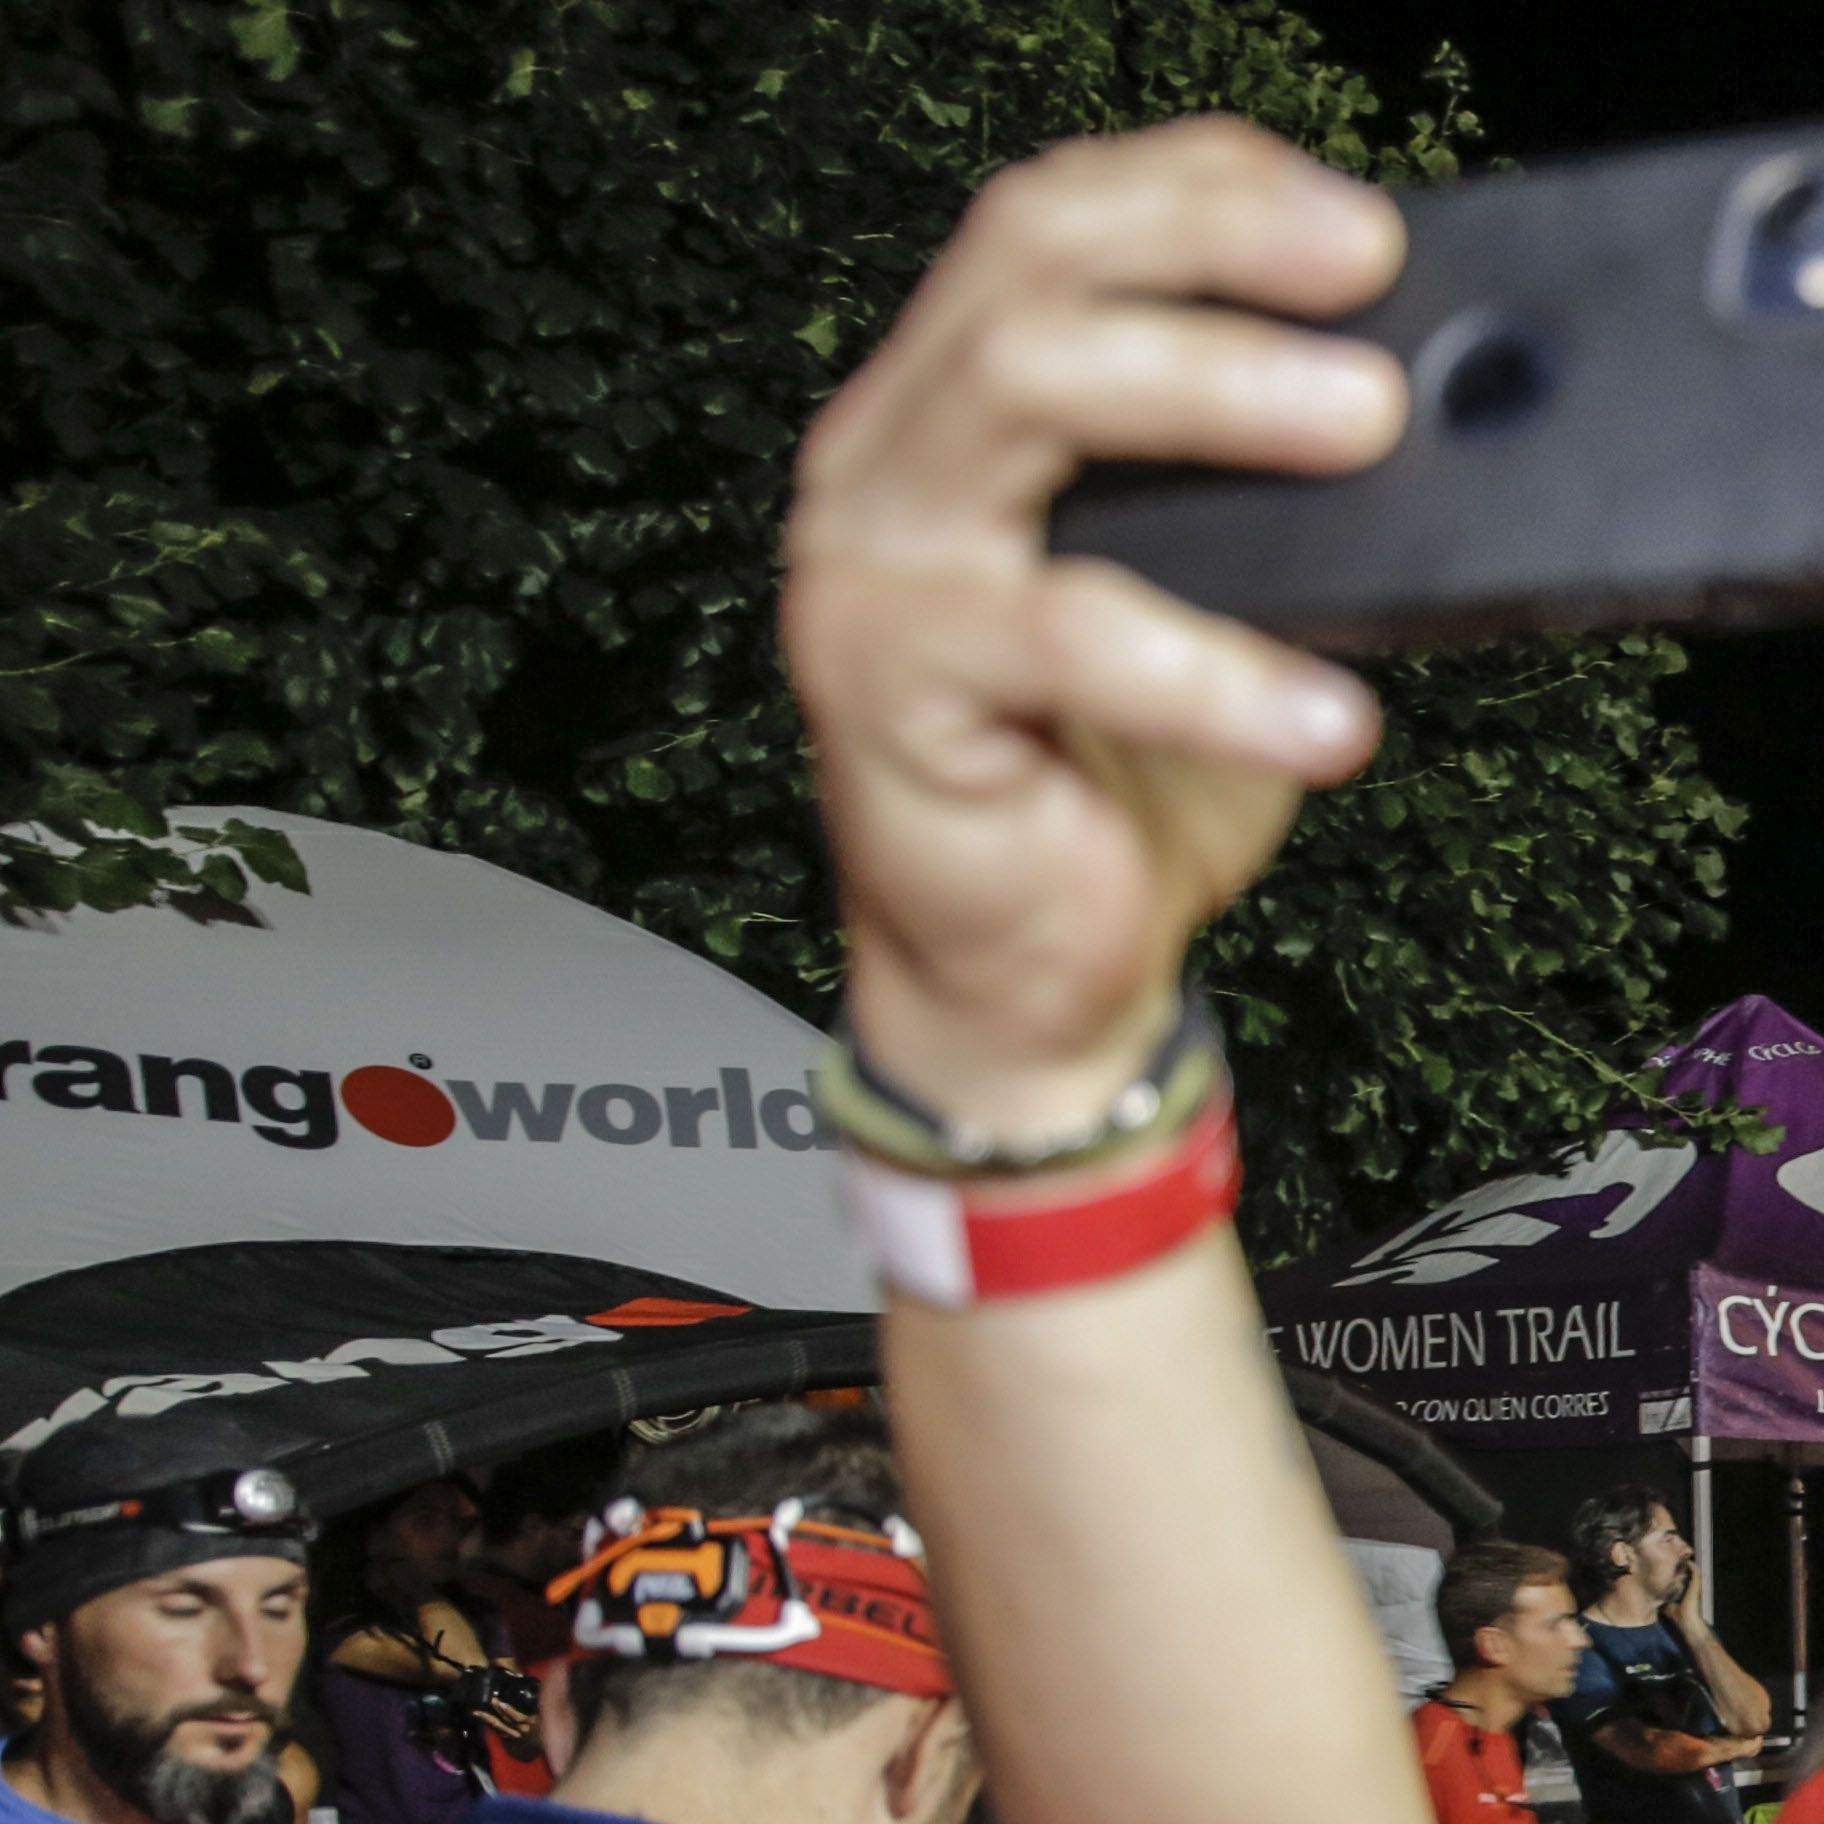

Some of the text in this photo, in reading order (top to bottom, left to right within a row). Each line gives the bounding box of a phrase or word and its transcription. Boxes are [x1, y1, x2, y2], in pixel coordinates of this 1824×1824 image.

[1297, 1311, 1485, 1374] WOMEN
[1497, 1301, 1637, 1364] TRAIL
[1463, 1389, 1526, 1423] QUIÉN
[1531, 1391, 1610, 1420] CORRES
